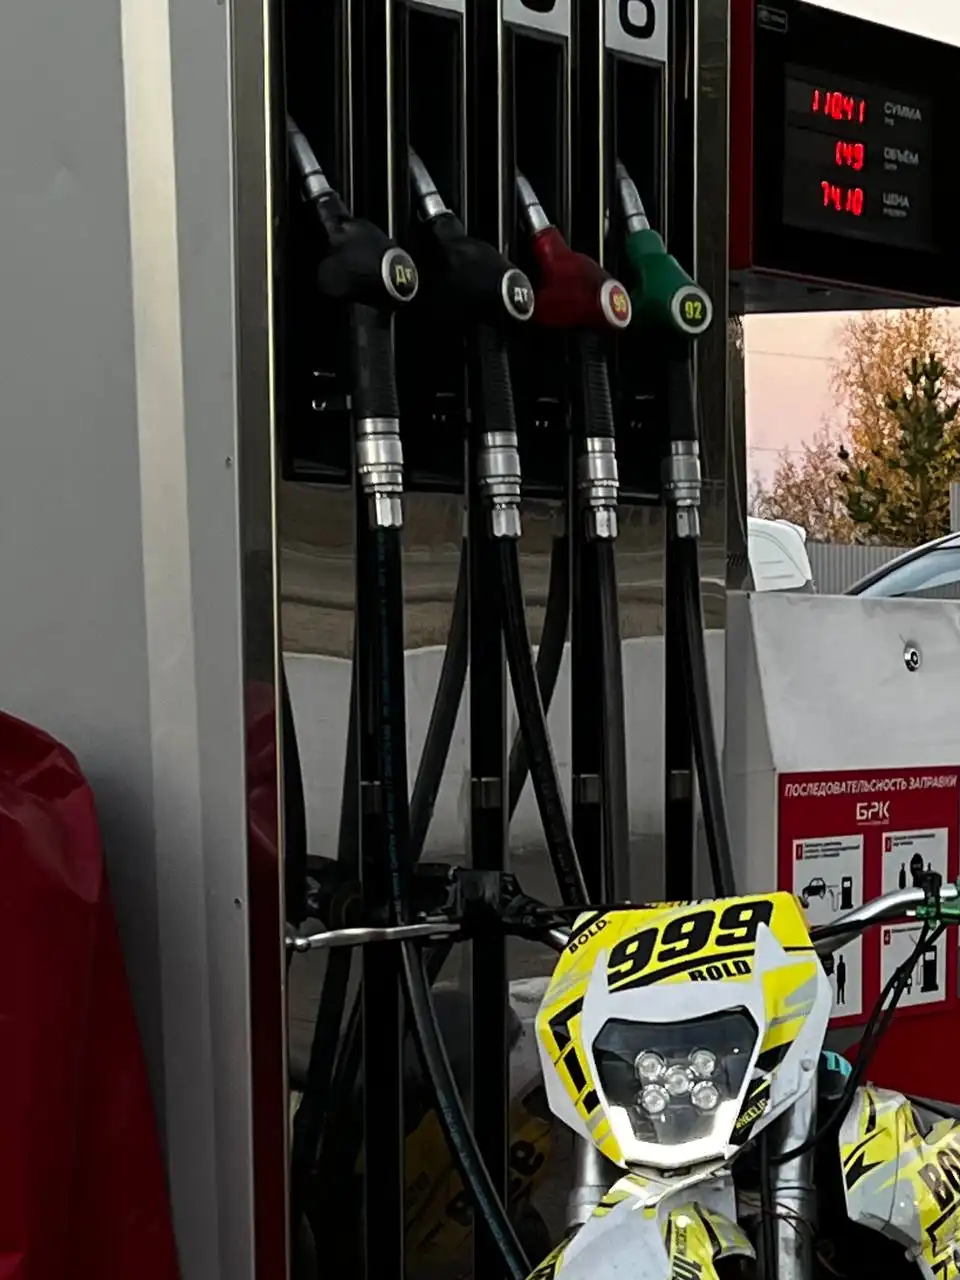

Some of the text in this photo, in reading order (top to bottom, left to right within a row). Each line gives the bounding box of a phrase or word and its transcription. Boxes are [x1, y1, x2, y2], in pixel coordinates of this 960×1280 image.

[883, 101, 922, 121] СУММА
[883, 191, 910, 208] ЦЕНА
[685, 300, 702, 319] 92
[908, 774, 958, 791] ЗАПРАВКИ
[855, 800, 891, 821] БРК
[567, 918, 609, 955] BOLD
[606, 900, 774, 979] 999
